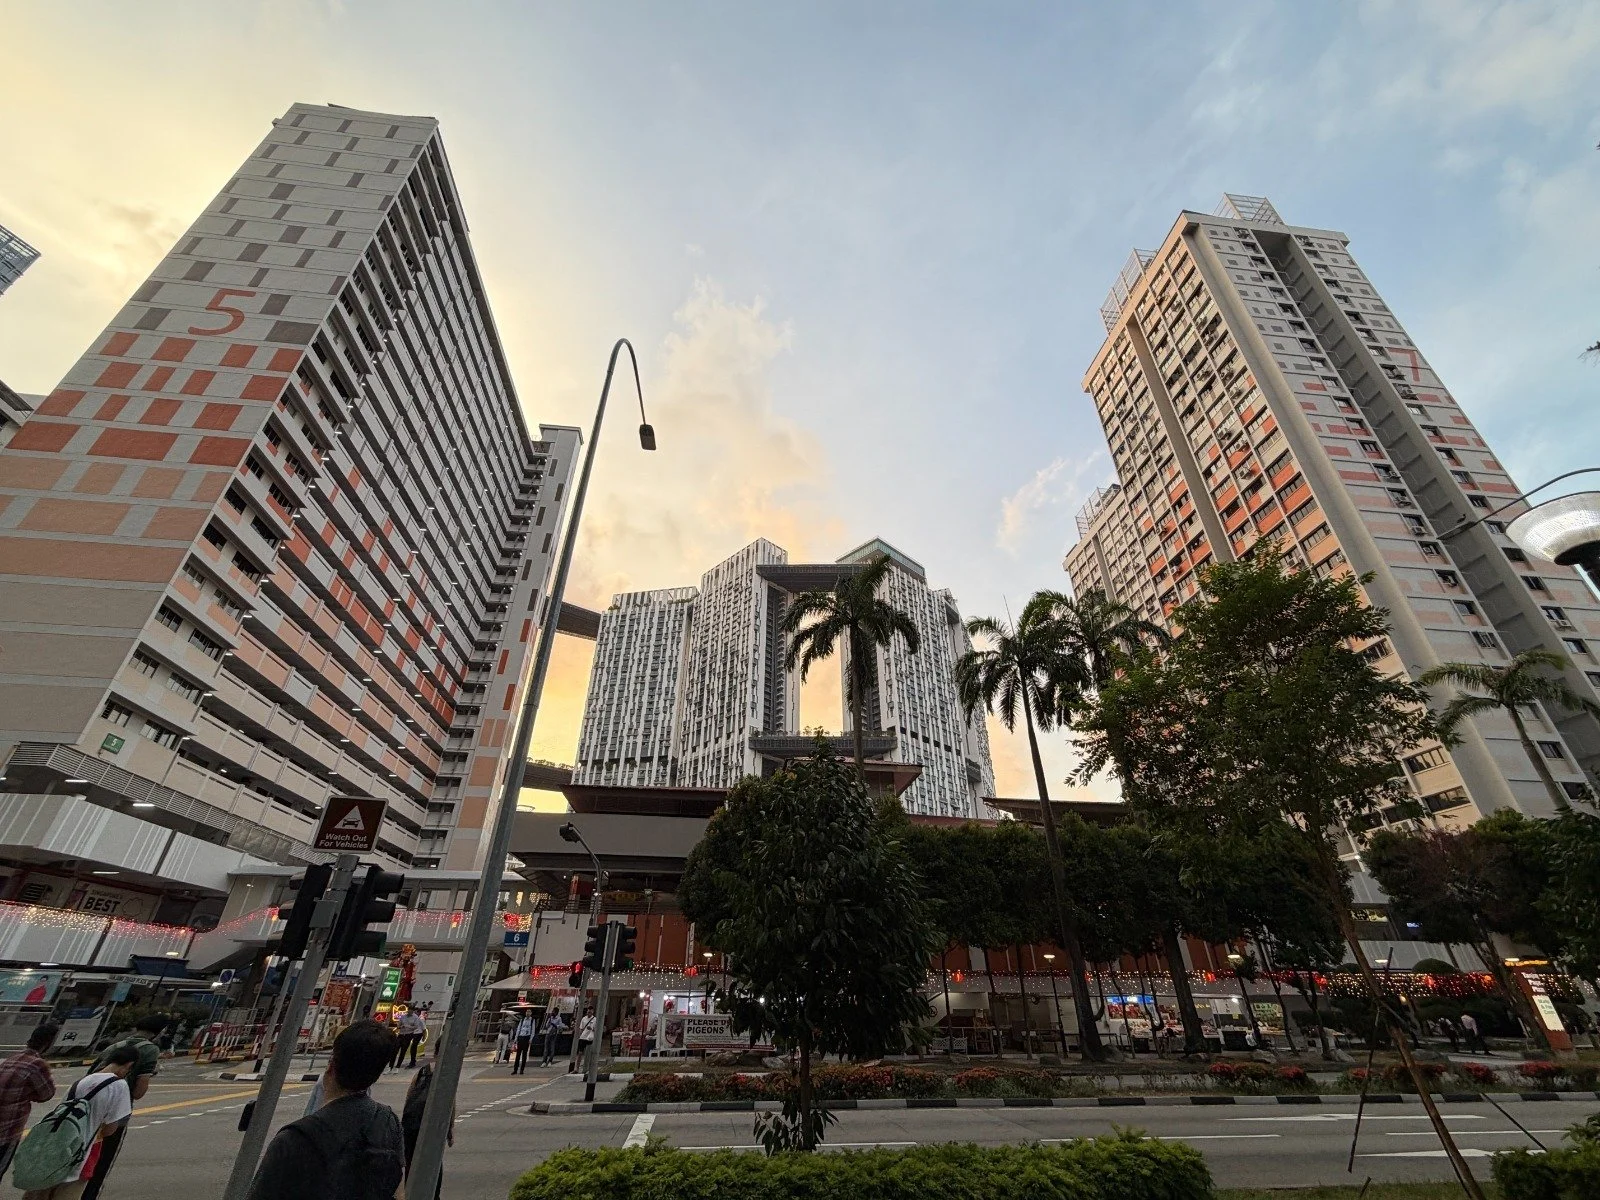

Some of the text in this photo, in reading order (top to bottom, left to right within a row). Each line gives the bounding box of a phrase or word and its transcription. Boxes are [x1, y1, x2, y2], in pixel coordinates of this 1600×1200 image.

[188, 288, 256, 336] 5
[325, 833, 367, 842] Watch Out
[319, 839, 369, 849] For Vehicles
[83, 896, 120, 914] BEST
[513, 933, 520, 942] 6
[687, 1018, 718, 1026] PLEASE
[686, 1026, 725, 1035] PIGEONS
